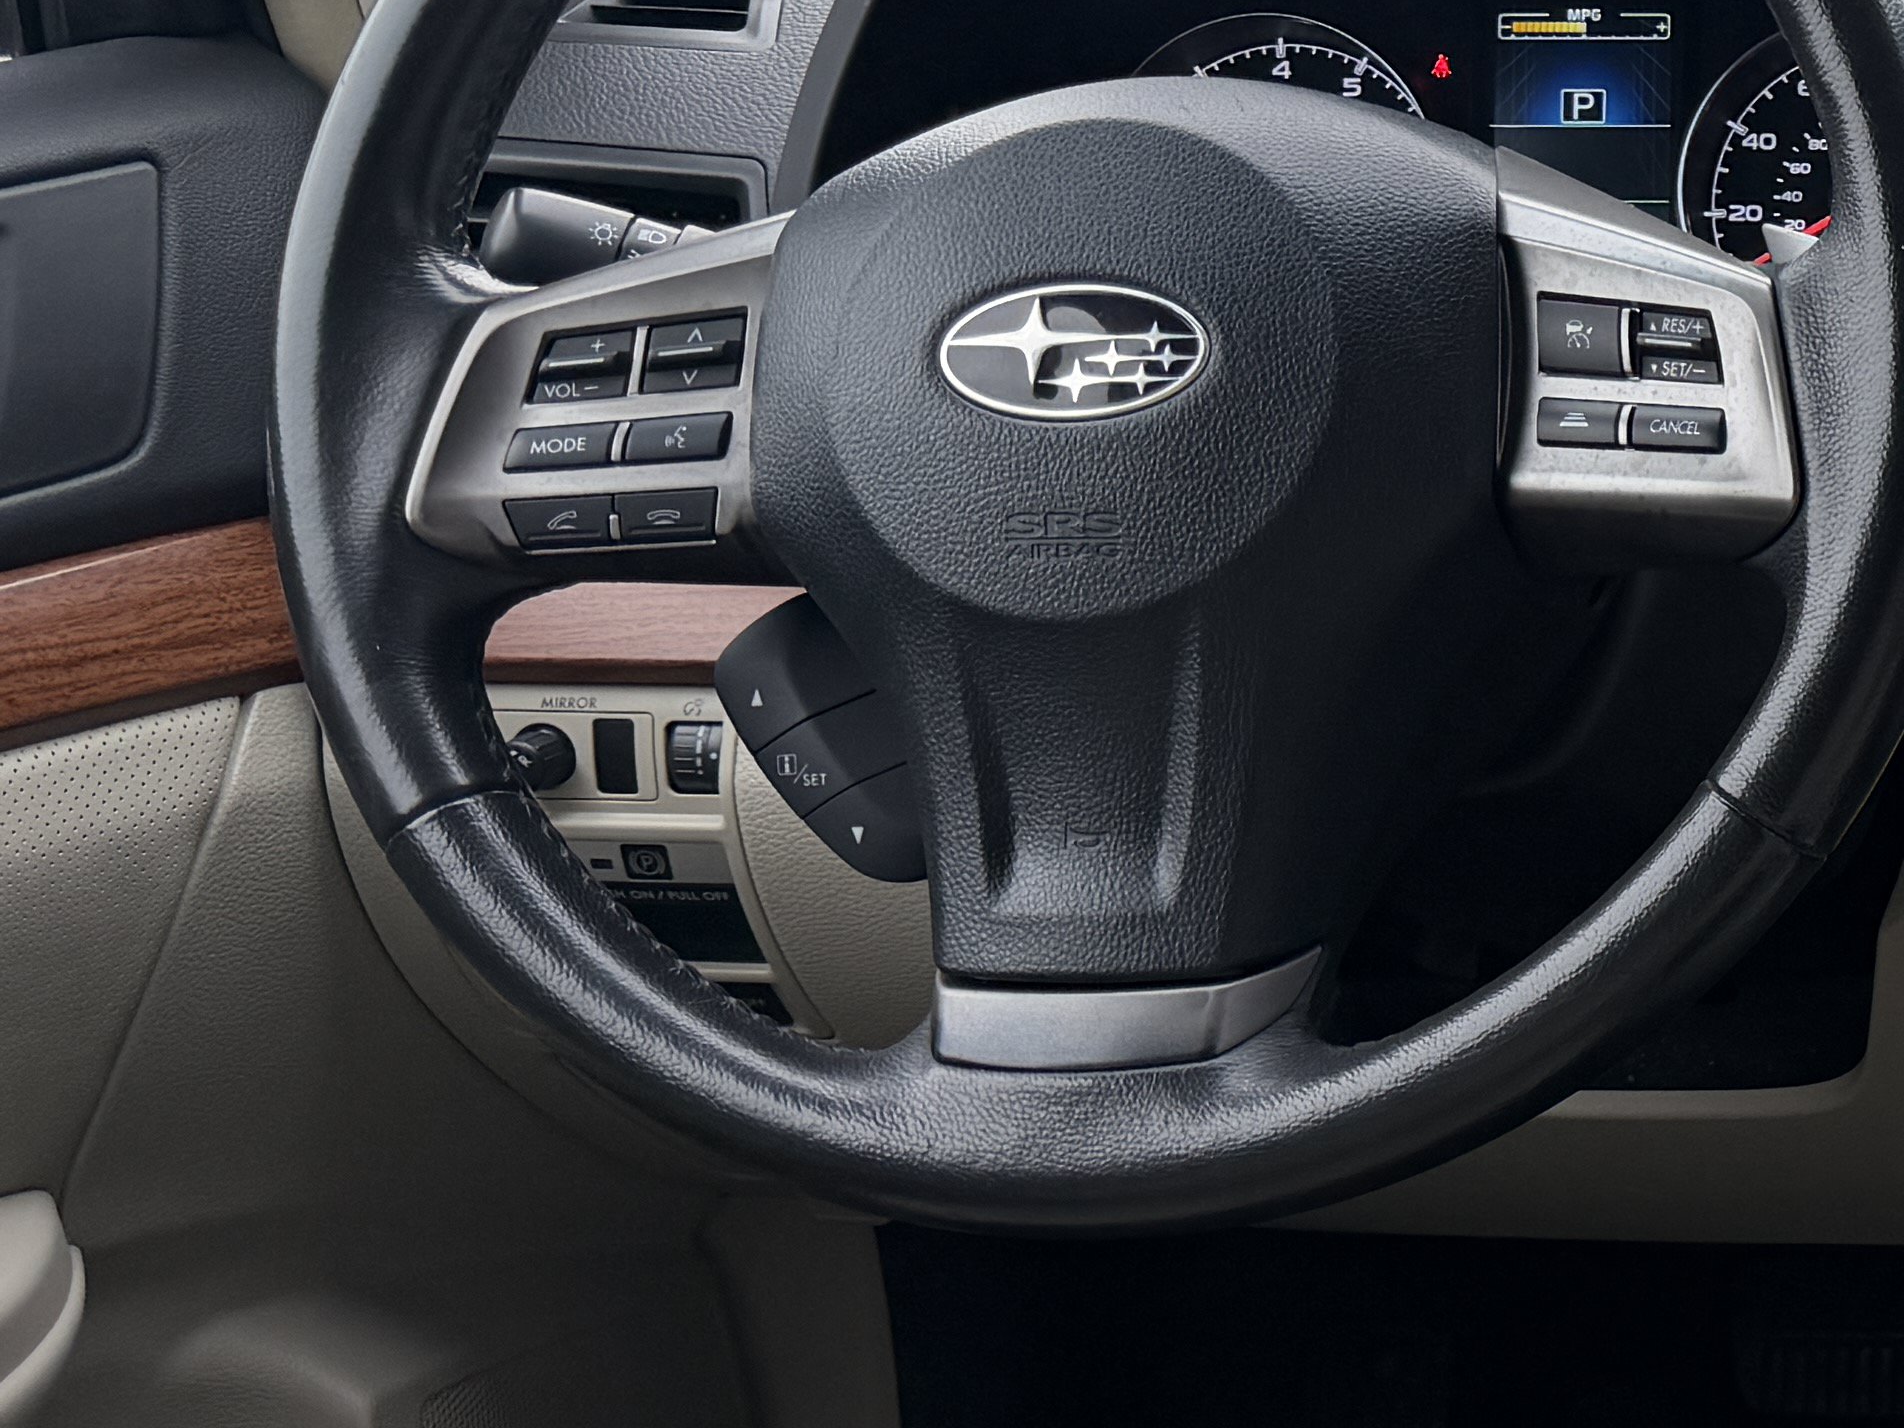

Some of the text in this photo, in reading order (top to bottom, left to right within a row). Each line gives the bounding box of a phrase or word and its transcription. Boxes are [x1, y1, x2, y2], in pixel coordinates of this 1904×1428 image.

[1567, 9, 1601, 21] MPG
[1272, 61, 1292, 79] 4
[1343, 78, 1362, 97] 5
[1573, 93, 1594, 120] P
[1742, 133, 1777, 150] 40
[1789, 162, 1811, 174] 60
[1781, 191, 1803, 202] 40
[1728, 204, 1763, 222] 20
[1784, 219, 1806, 230] 20
[544, 384, 580, 399] VOL
[1650, 420, 1700, 435] CANCEL
[530, 436, 587, 455] MODE
[1004, 512, 1122, 538] SRS
[540, 696, 598, 710] MIRROR
